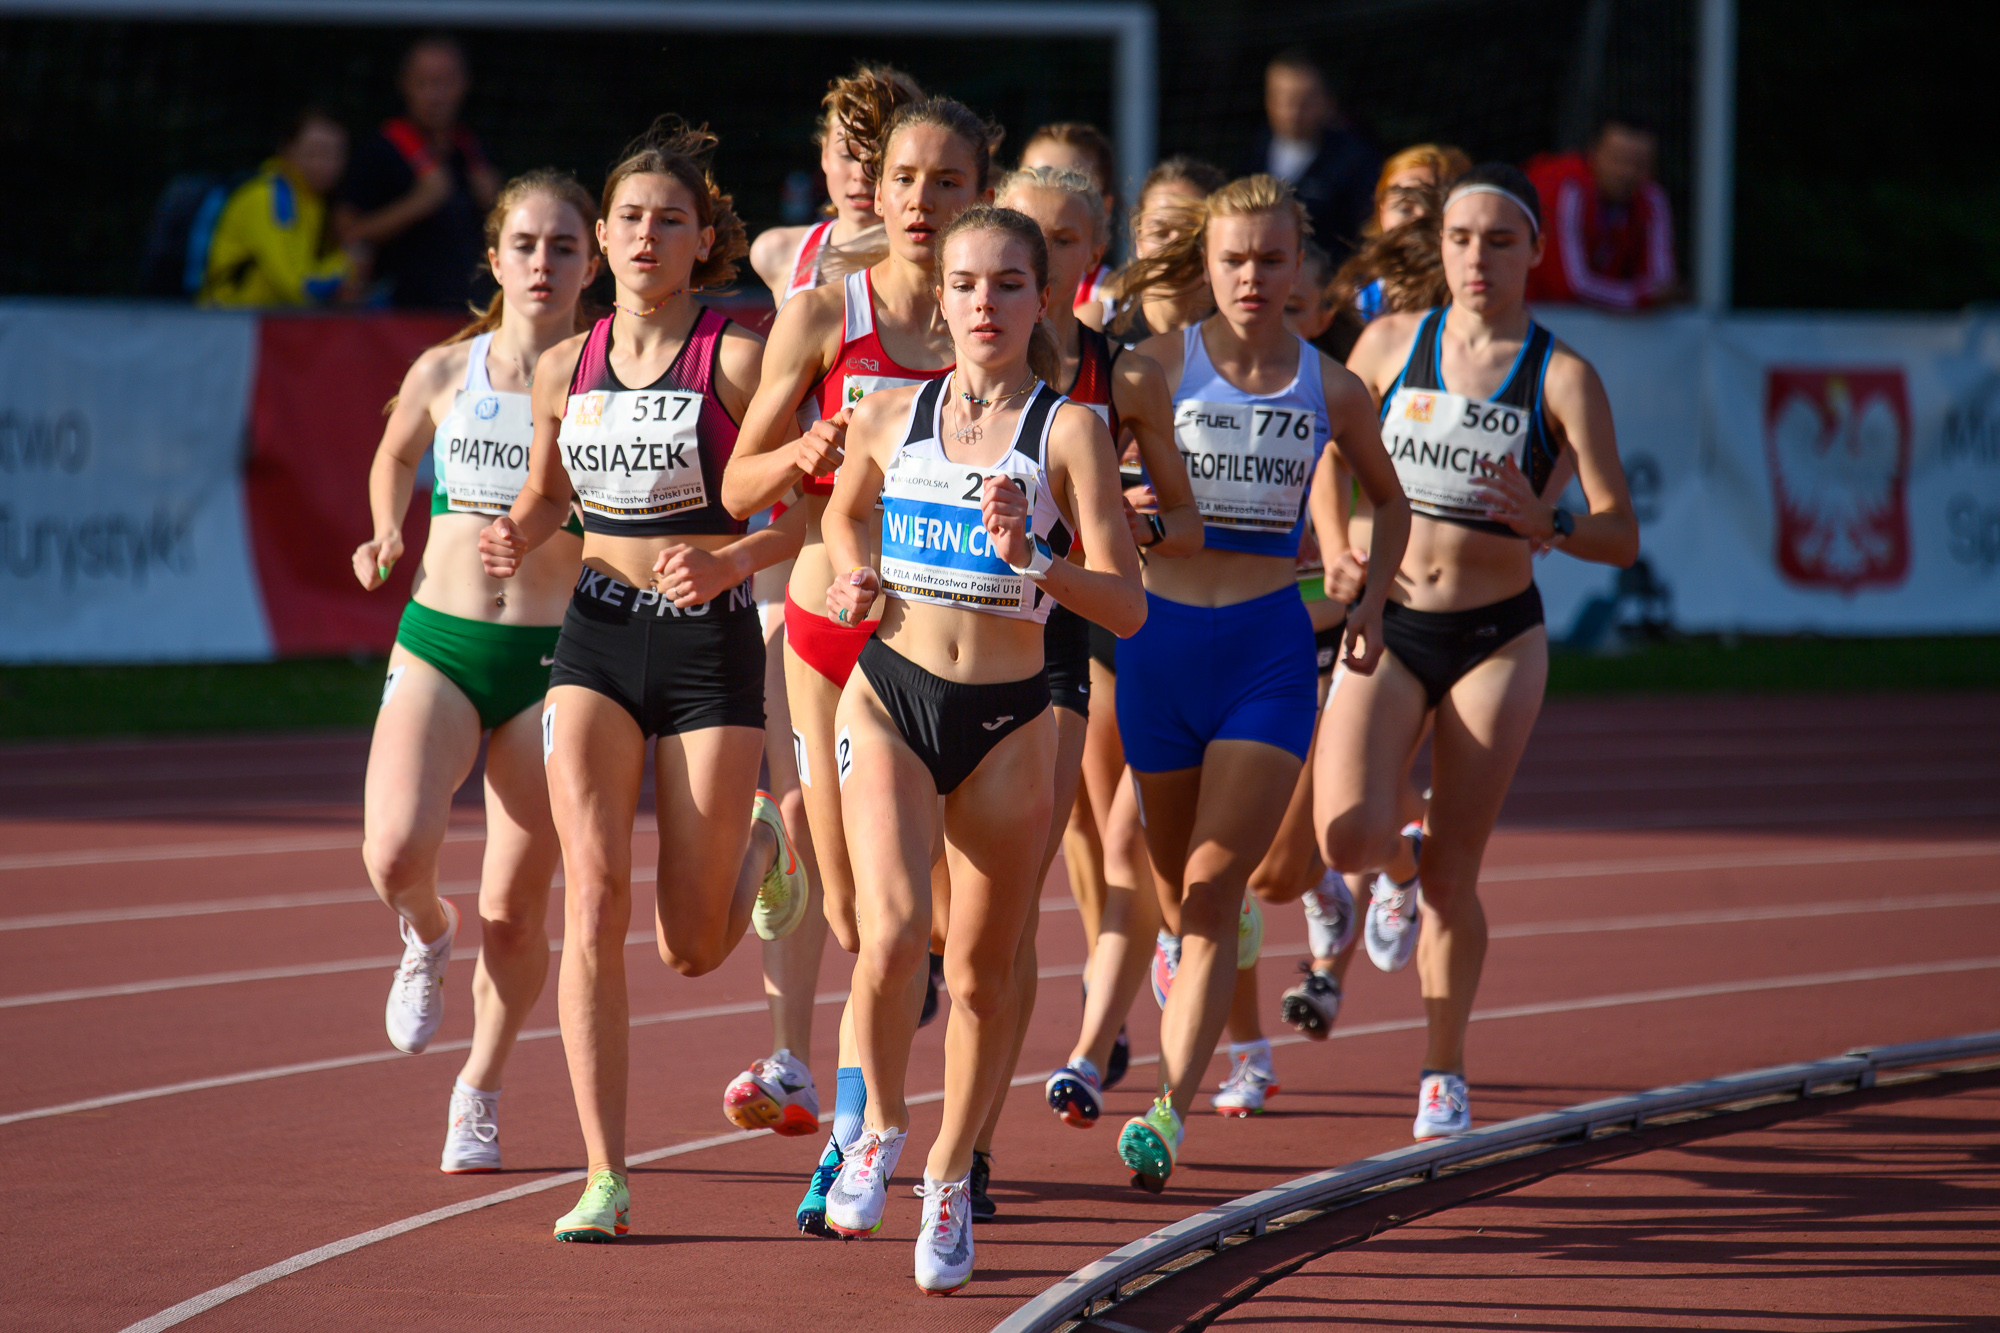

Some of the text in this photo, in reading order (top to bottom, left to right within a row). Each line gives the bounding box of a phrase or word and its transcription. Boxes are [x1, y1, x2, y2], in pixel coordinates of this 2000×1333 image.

[632, 396, 692, 421] 517
[1195, 414, 1241, 430] FUEL
[1462, 403, 1519, 435] 560
[1255, 410, 1310, 441] 776
[567, 436, 690, 477] KSIĄŻEK
[1181, 451, 1306, 487] TEOFILEWSKA
[653, 489, 681, 502] Polski
[683, 486, 702, 496] U18
[962, 472, 1027, 502] 20
[887, 511, 1001, 558] WIERNICK
[576, 563, 630, 607] IKE
[893, 568, 910, 580] PZLA
[912, 572, 968, 588] Mistrzostwa
[970, 581, 1001, 594] Polski
[1003, 584, 1022, 595] U18
[839, 737, 850, 777] 2
